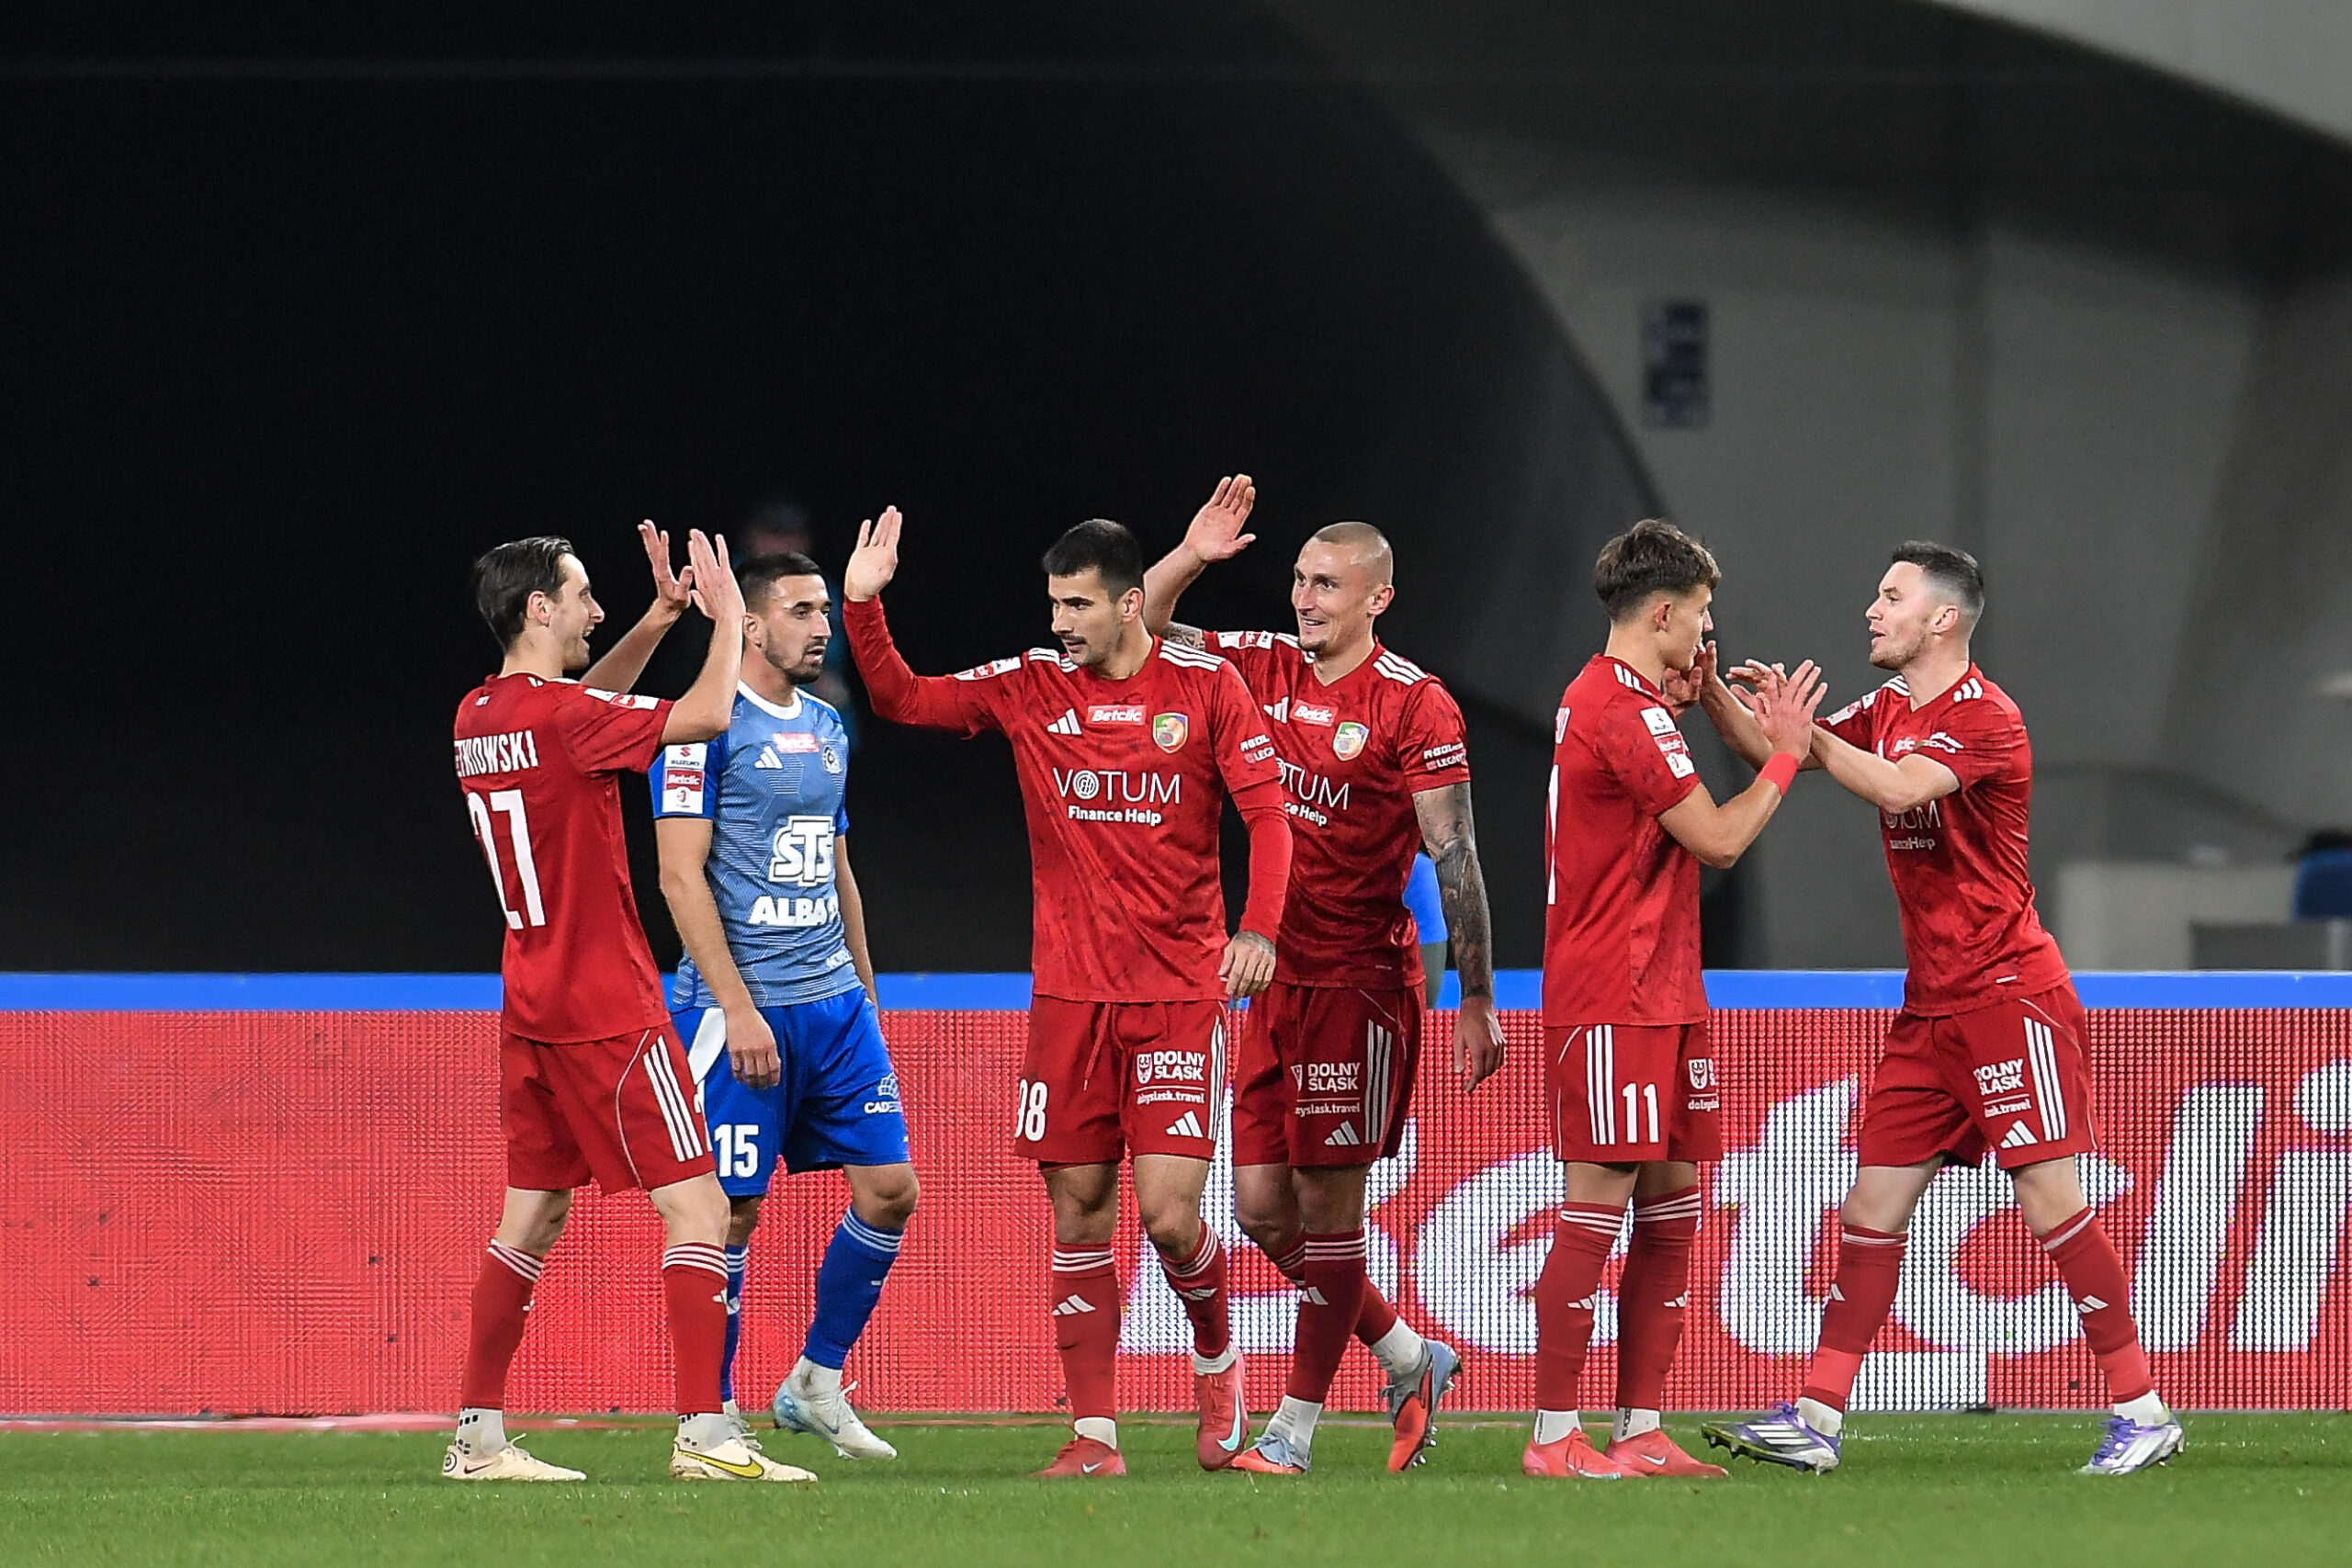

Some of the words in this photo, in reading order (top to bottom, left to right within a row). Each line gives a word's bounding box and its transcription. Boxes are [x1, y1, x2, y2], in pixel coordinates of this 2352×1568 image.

[1091, 708, 1142, 723] Betclic
[1052, 767, 1181, 804] VOTUM
[1068, 805, 1124, 822] Finance
[1125, 807, 1162, 827] Help
[1298, 804, 1328, 828] Help
[467, 788, 546, 931] 27
[768, 815, 836, 887] STS
[1153, 1050, 1205, 1067] DOLNY
[1307, 1062, 1361, 1077] DOLNY
[1622, 1082, 1660, 1144] 11
[714, 1123, 759, 1179] 15
